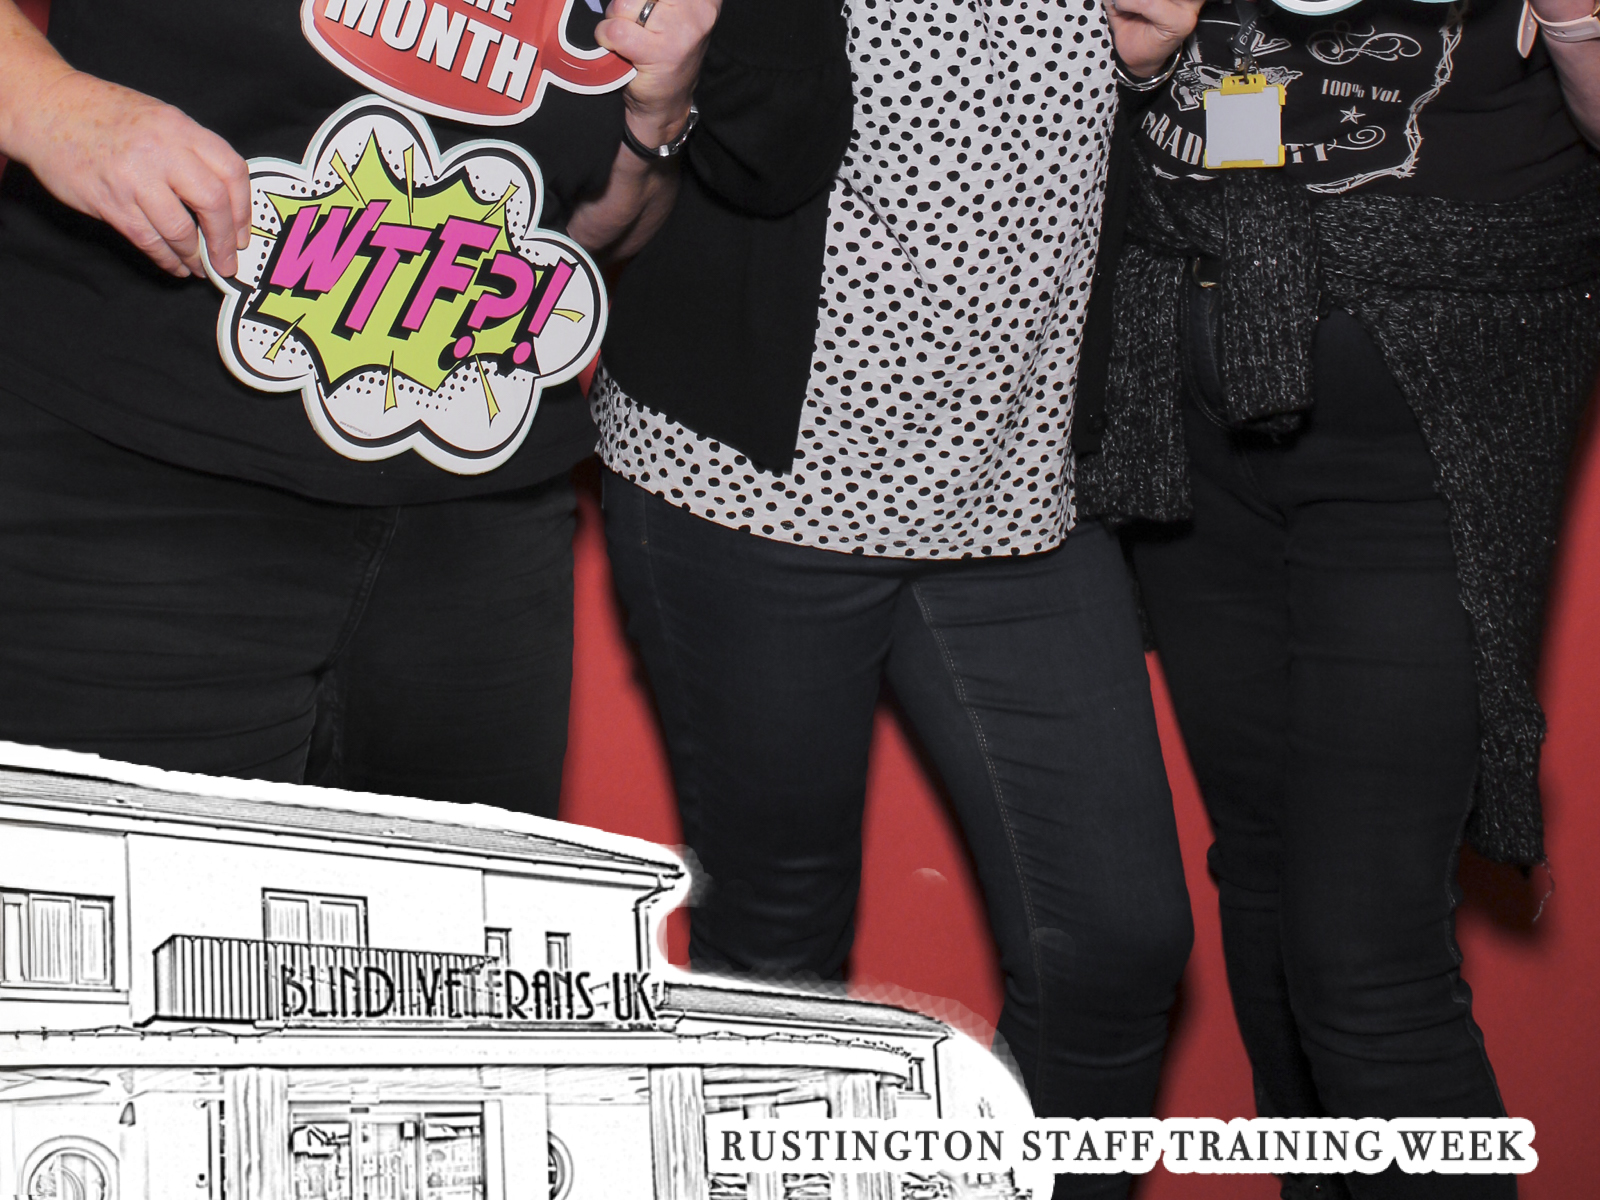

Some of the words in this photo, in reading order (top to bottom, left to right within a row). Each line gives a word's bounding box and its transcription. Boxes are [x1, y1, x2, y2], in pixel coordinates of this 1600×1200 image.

[1321, 78, 1366, 99] 100%
[1370, 85, 1403, 103] Vol.
[262, 199, 579, 368] WTF?!
